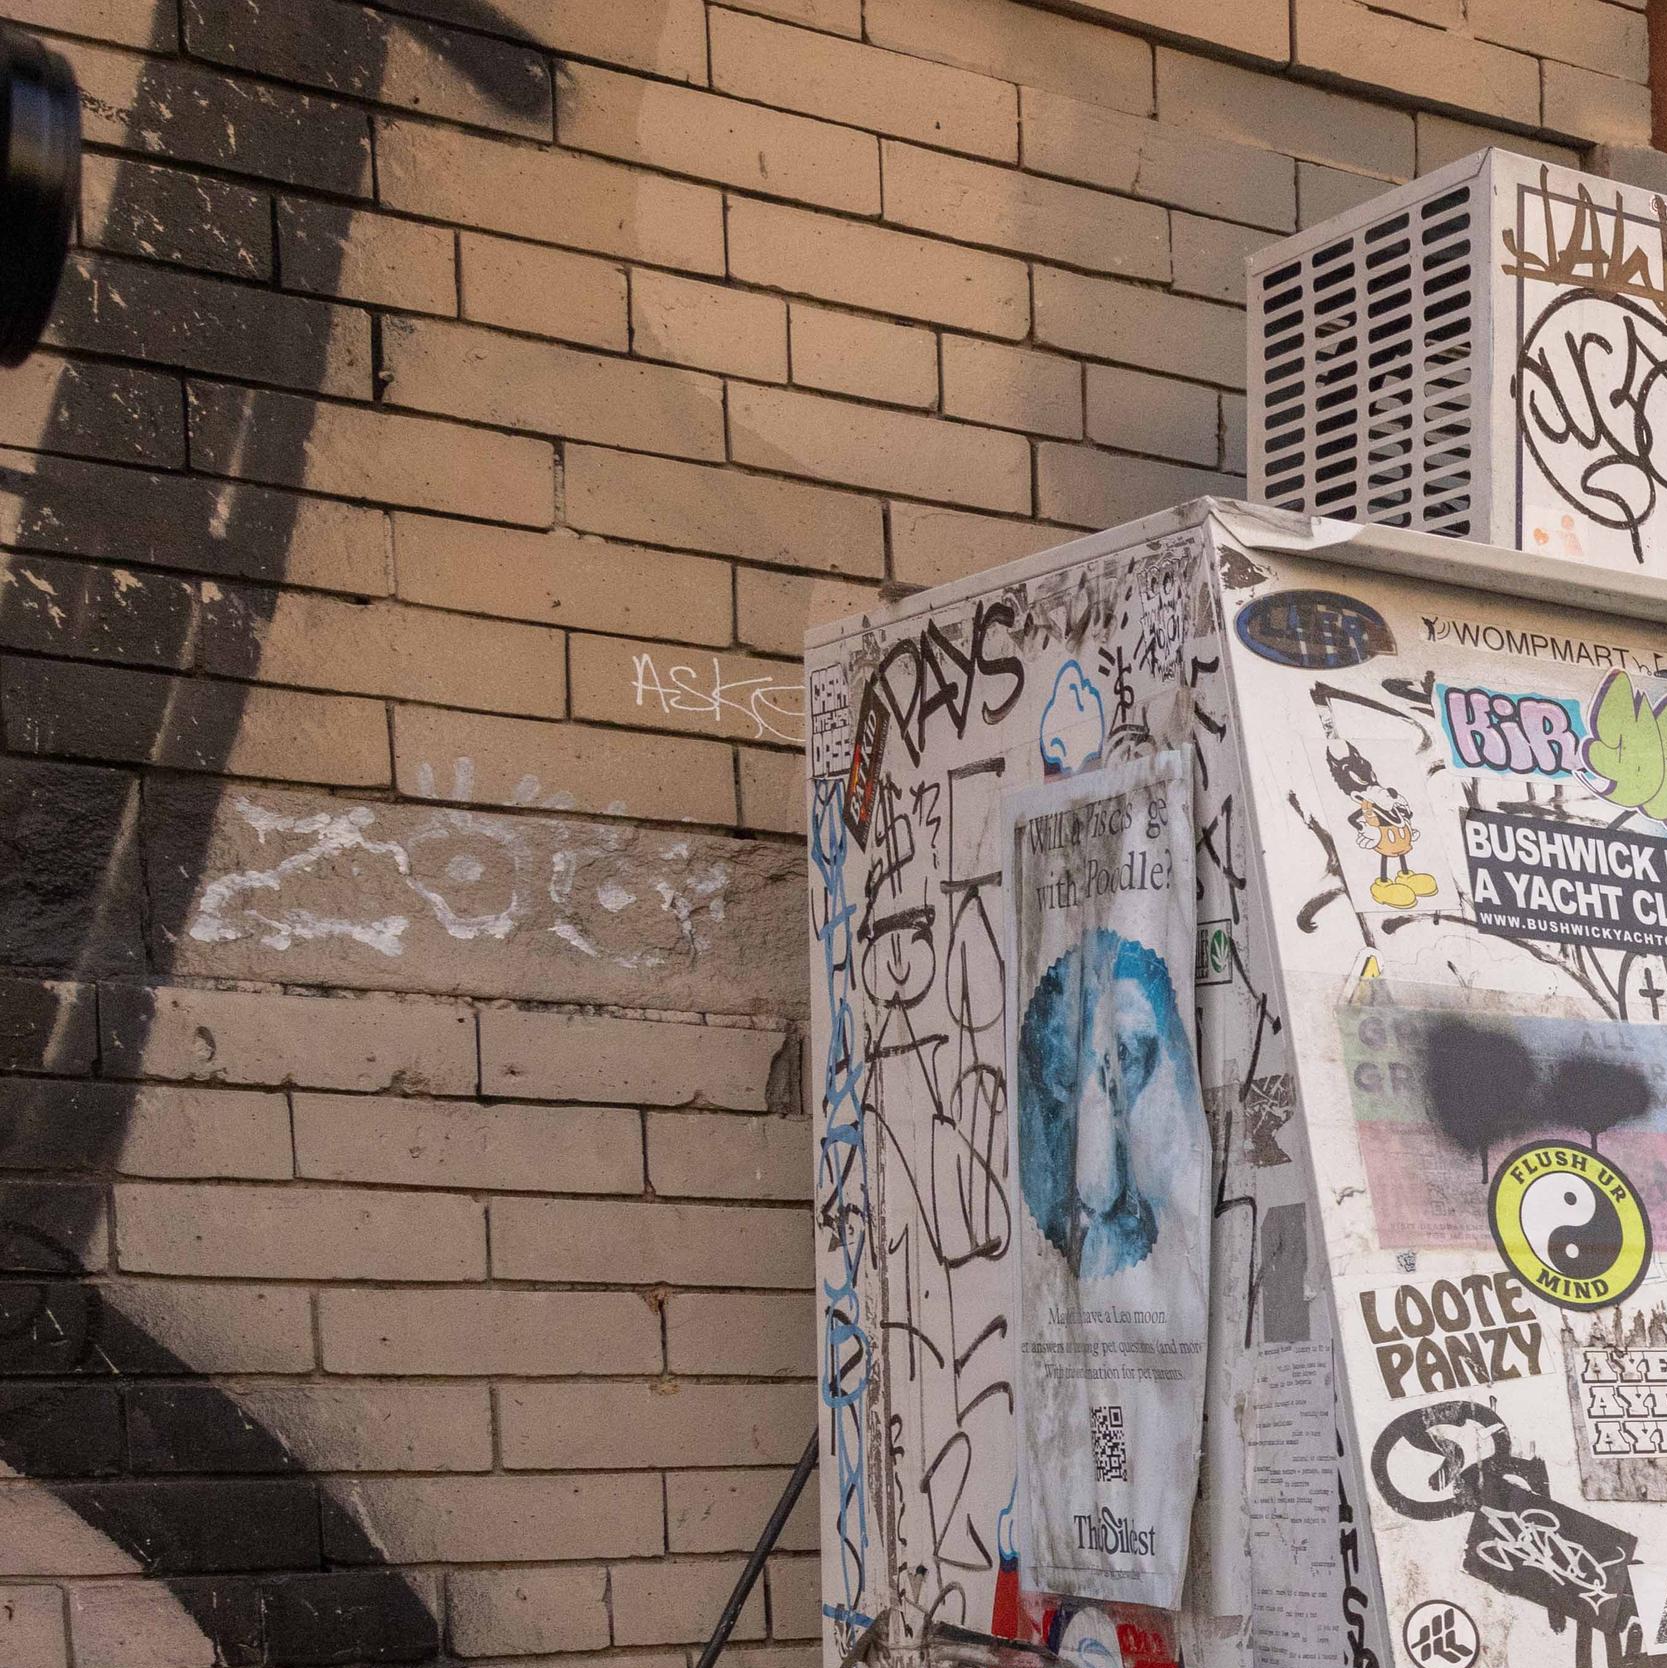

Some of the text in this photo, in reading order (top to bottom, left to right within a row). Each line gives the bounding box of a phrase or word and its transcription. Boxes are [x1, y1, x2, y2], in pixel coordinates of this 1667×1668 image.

[1452, 620, 1630, 668] WOMPMART
[1466, 820, 1655, 884] BUSHWICK
[1474, 868, 1501, 905] A
[1499, 870, 1624, 922] YACHT
[1511, 1150, 1627, 1205] FLUSH UR
[1535, 1268, 1610, 1299] MIND
[1375, 1320, 1544, 1398] PANZY
